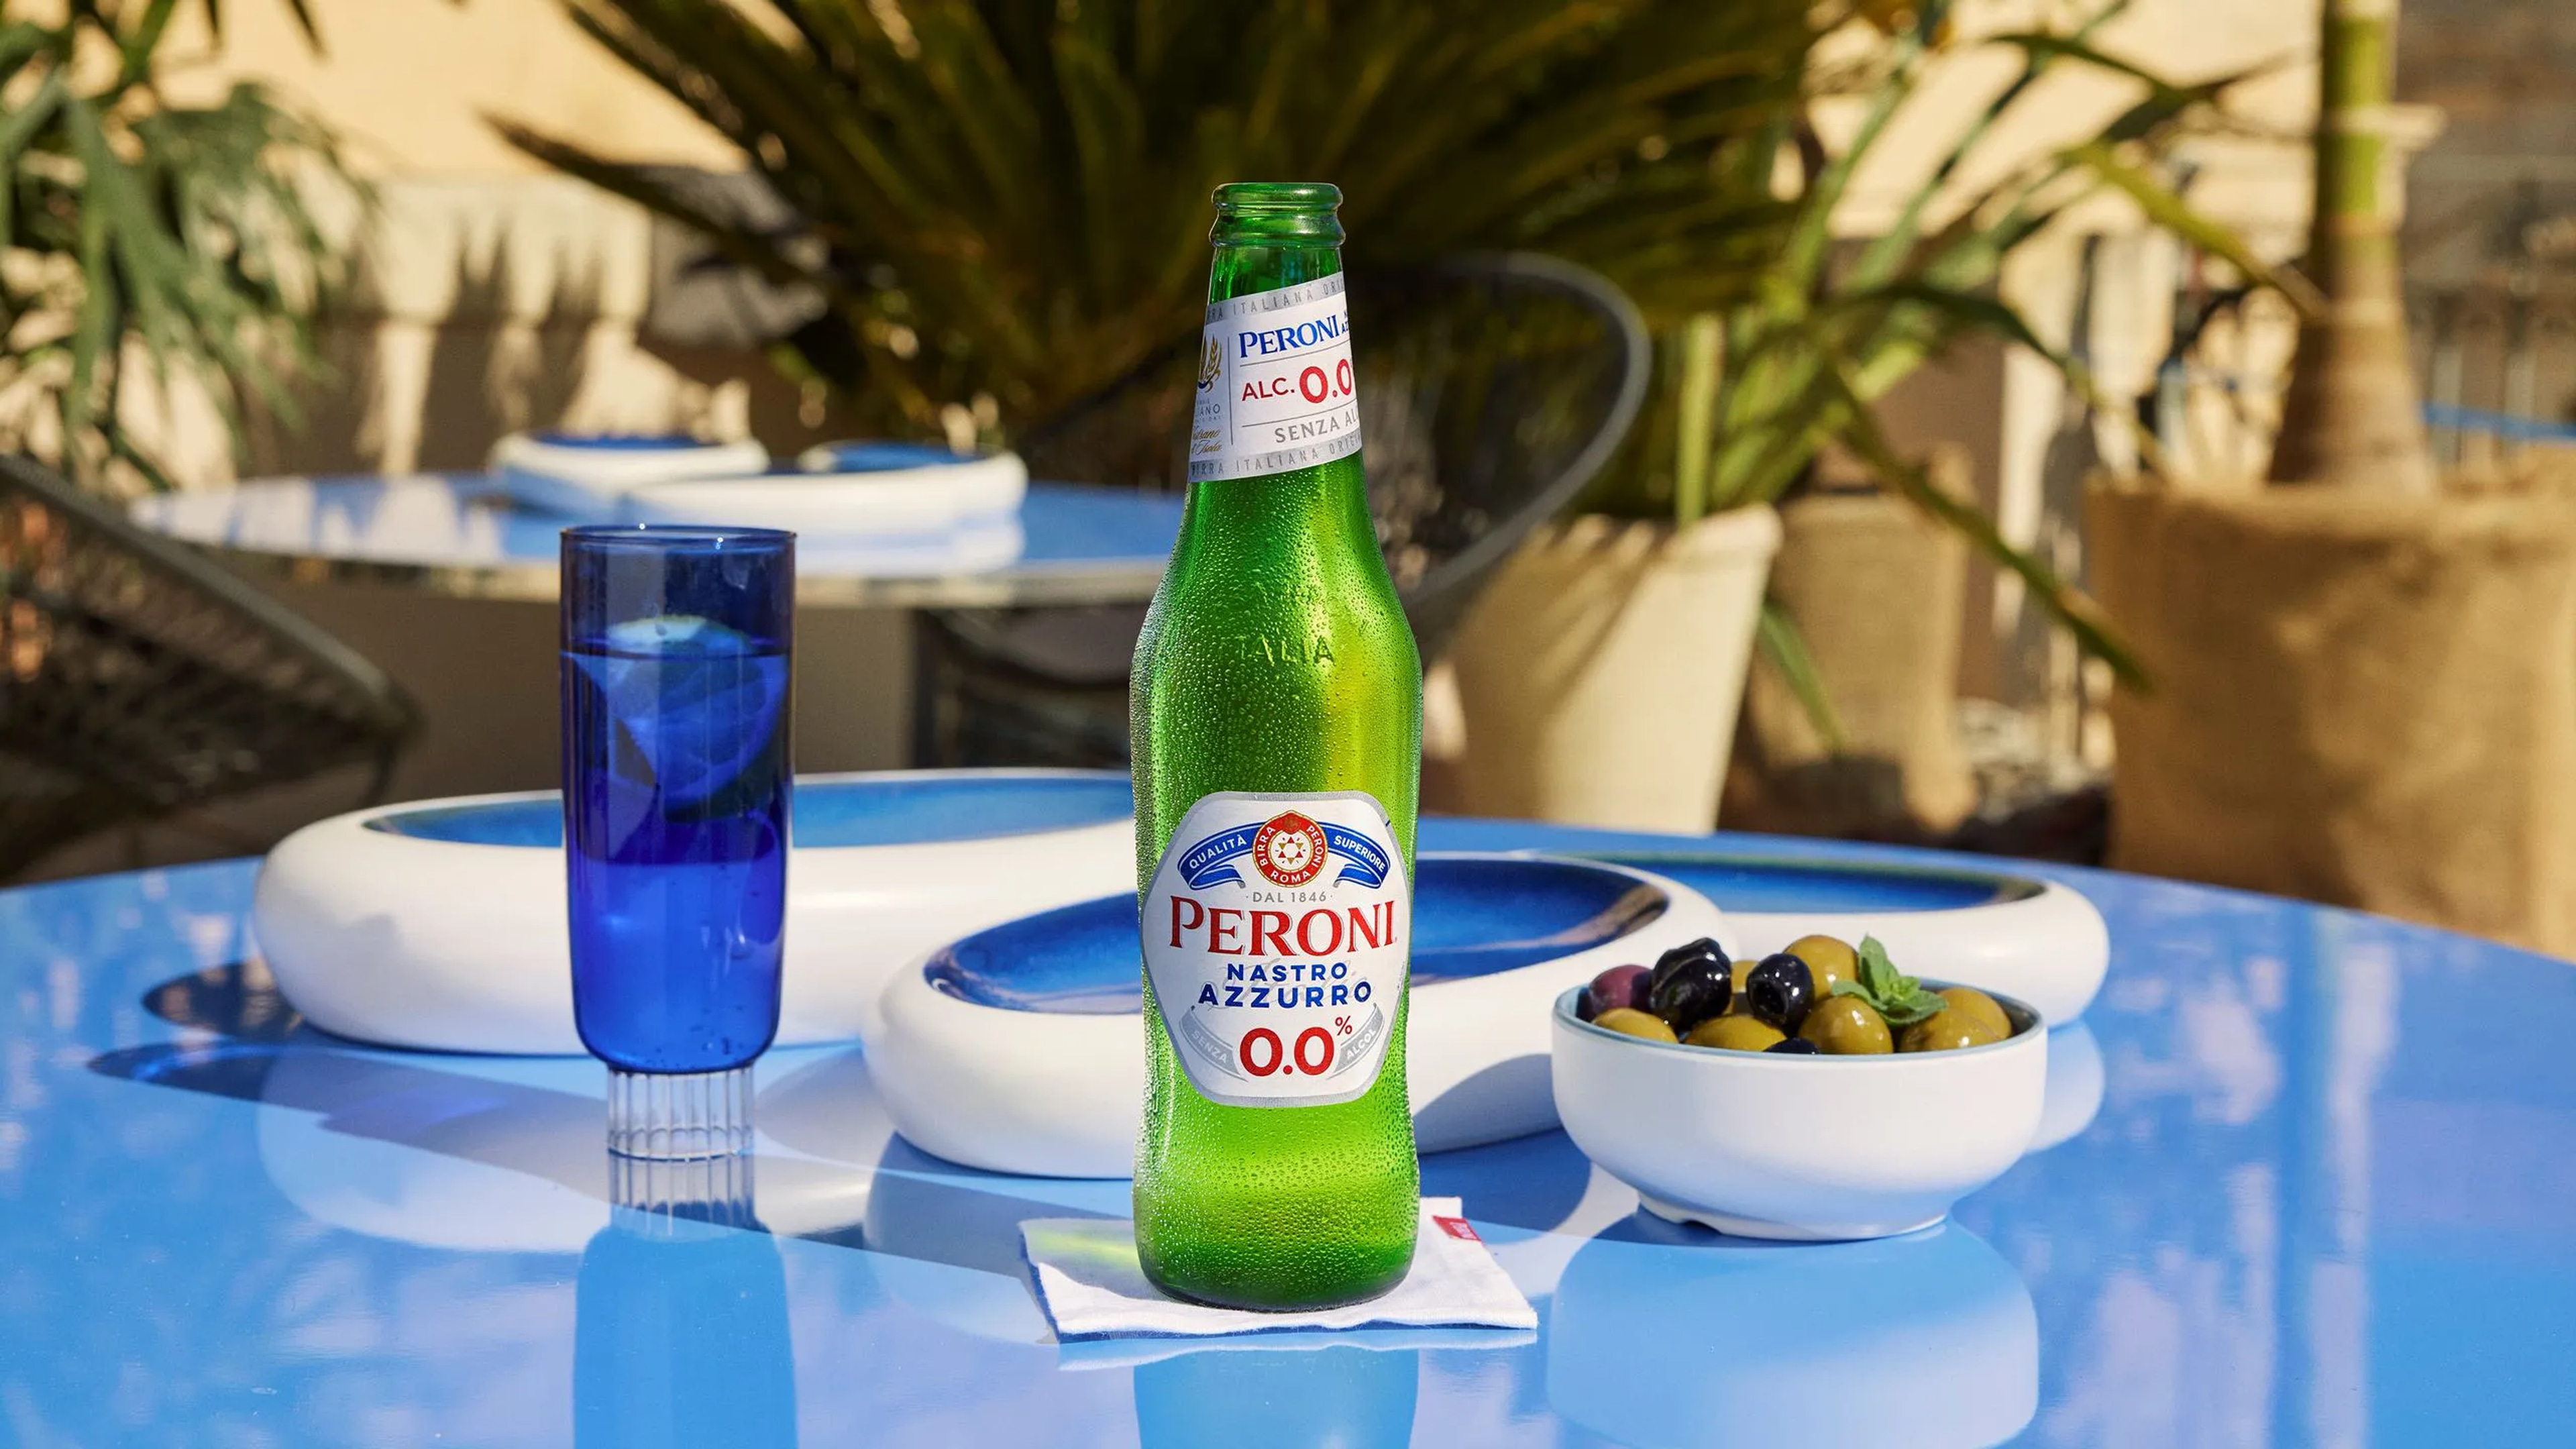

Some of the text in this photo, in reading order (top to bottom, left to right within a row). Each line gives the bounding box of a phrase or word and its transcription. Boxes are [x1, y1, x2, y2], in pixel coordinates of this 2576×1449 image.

[1233, 290, 1313, 315] ITALIANA
[1238, 315, 1340, 358] PERONI
[1242, 358, 1352, 403] ALC. 0.0
[1274, 416, 1340, 443] SENZA
[1236, 448, 1319, 472] ITALIANA
[1189, 834, 1386, 872] QUALITÀ SUPERIORE
[1256, 825, 1325, 867] BIRRA PERONI
[1271, 870, 1311, 883] ROMA
[1252, 889, 1327, 903] DAL 1846
[1169, 895, 1395, 957] PERONI
[1227, 961, 1348, 981] NASTRO
[1197, 981, 1372, 1008] AZZURRO
[1192, 1029, 1377, 1063] SENZA ALCOL
